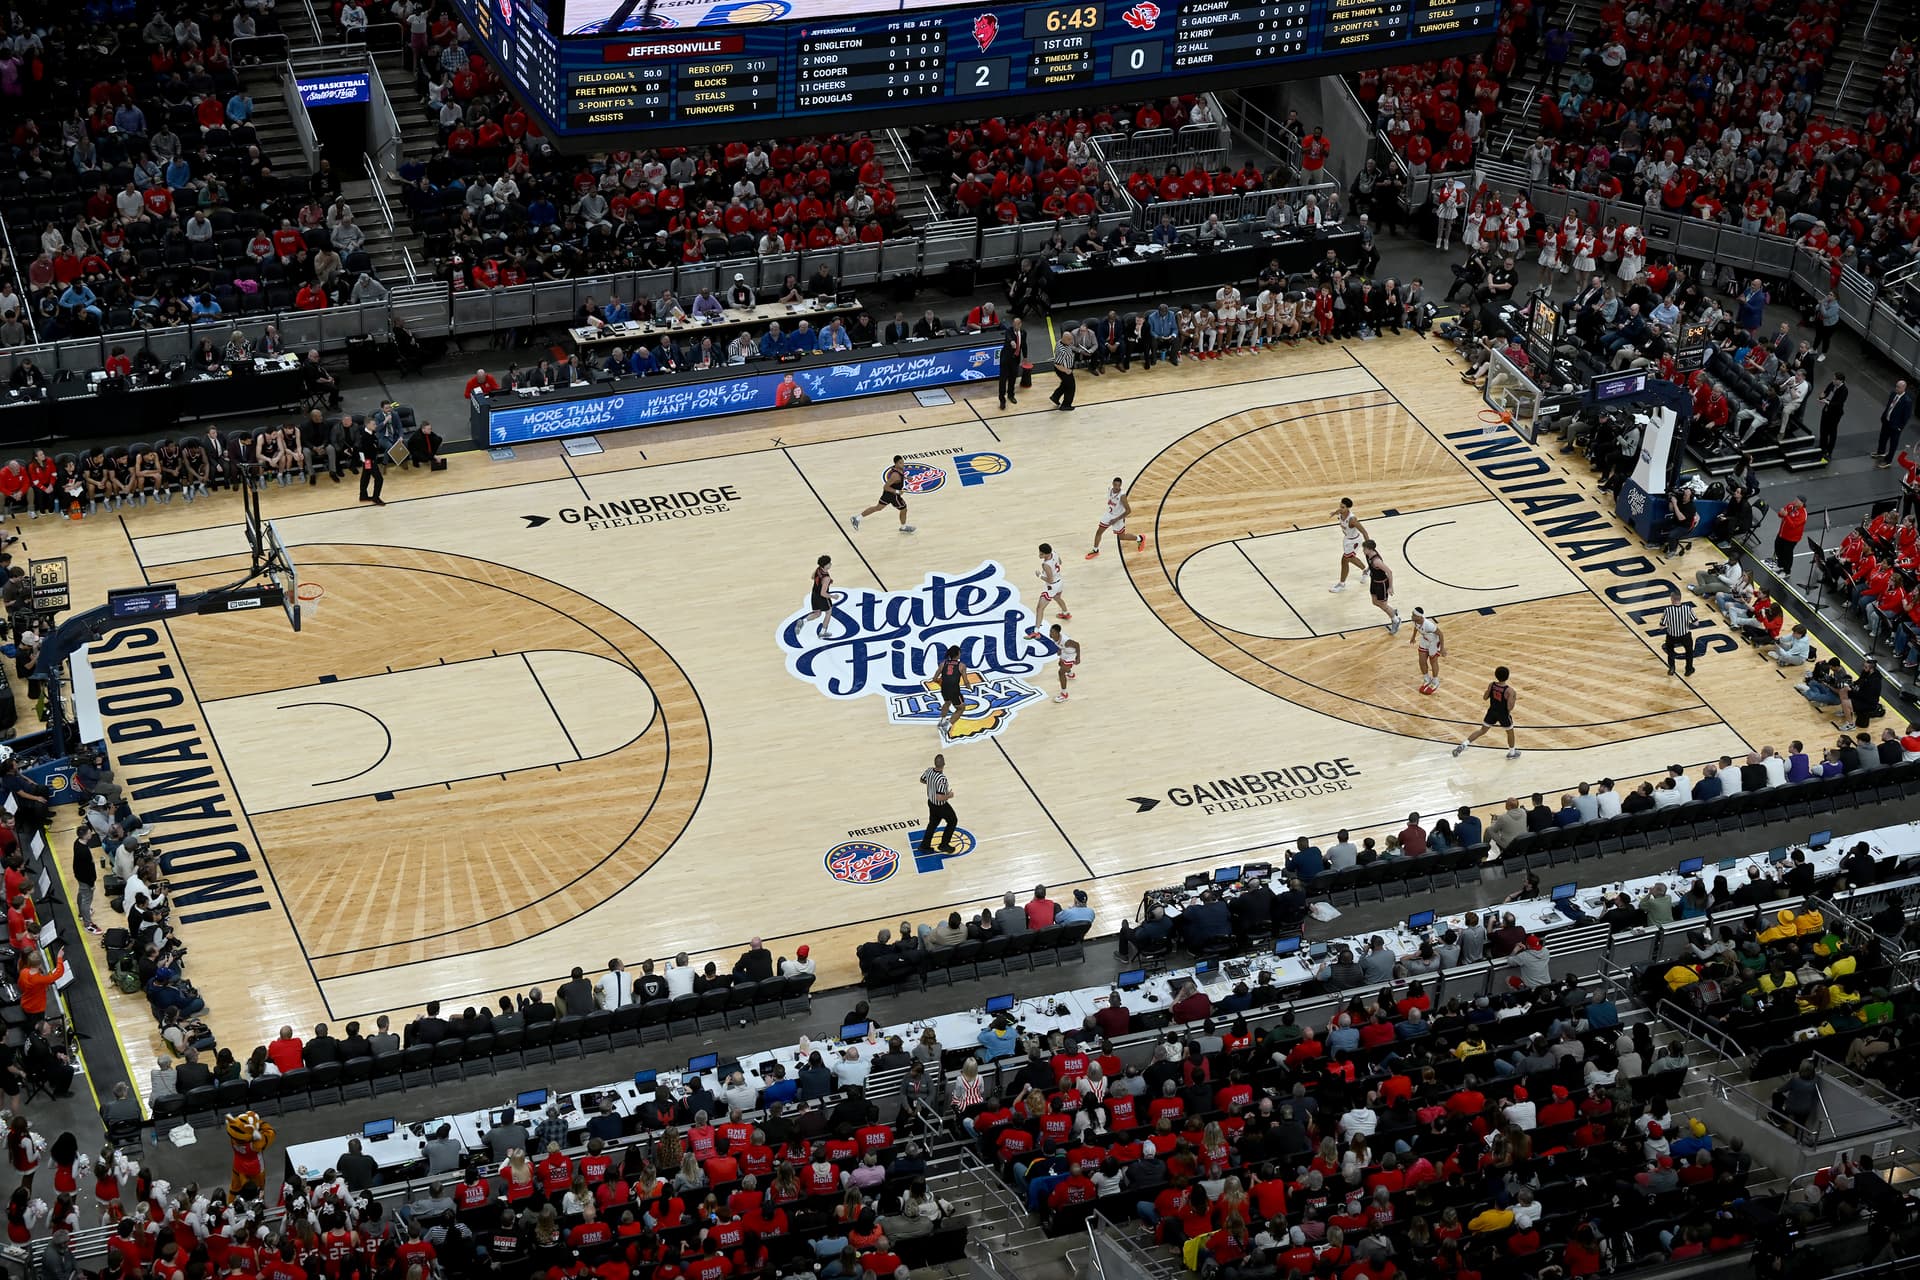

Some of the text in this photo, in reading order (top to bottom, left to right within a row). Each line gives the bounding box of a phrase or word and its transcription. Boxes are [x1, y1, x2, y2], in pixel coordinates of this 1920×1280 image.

[1192, 1, 1229, 12] ZACHARY
[1047, 7, 1097, 31] 6:43
[1191, 14, 1228, 25] GARDNER
[1229, 12, 1241, 21] JR.
[1332, 11, 1350, 20] FREE
[1351, 8, 1377, 17] THROW
[1428, 9, 1454, 19] STEALS
[811, 26, 856, 36] JEFFERSONVILLE
[1333, 22, 1362, 33] 3-POINT
[1420, 21, 1460, 33] TURNOVERS
[1179, 28, 1214, 40] 12 KIRBY
[1340, 34, 1370, 44] ASSISTS
[627, 41, 721, 57] JEFFERSONVILLE
[814, 39, 862, 51] SINGLETON
[1044, 37, 1082, 50] 1ST QTR
[1177, 42, 1209, 53] 22 HALL
[814, 55, 838, 64] NORD
[1045, 53, 1079, 63] TIMEOUTS
[1131, 49, 1144, 69] 0
[1188, 54, 1213, 64] BAKER
[688, 66, 710, 74] REBS
[711, 64, 733, 74] (OFF)
[754, 61, 765, 71] (1)
[813, 67, 848, 78] COOPER
[1050, 64, 1072, 72] FOULS
[578, 74, 602, 82] FIELD
[603, 72, 626, 81] GOAL
[644, 69, 662, 78] 50.0
[975, 66, 989, 86] 2
[1045, 74, 1075, 83] PENALTY
[319, 80, 366, 90] BASKETBALL
[694, 78, 727, 87] BLOCKS
[800, 84, 809, 92] 11
[813, 81, 846, 91] CHEEKS
[575, 88, 596, 96] FREE
[598, 85, 629, 95] THROW
[646, 83, 659, 91] 0.0
[695, 91, 726, 101] STEALS
[800, 97, 810, 105] 12
[812, 93, 852, 104] DOUGLAS
[578, 100, 612, 110] 3-POINT
[646, 97, 659, 105] 0.0
[685, 104, 734, 115] TURNOVERS
[589, 113, 623, 122] ASSISTS
[869, 356, 936, 377] APPLY NOW
[855, 380, 871, 392] AT
[648, 382, 748, 407] WHICH ONE IS
[640, 389, 759, 418] MEANT FOR YOU?
[523, 398, 624, 424] MORE THAN 70
[532, 414, 615, 434] PROGRAMS.
[902, 449, 952, 460] PRESENTED
[559, 485, 741, 524] GAINBRIDGE
[587, 503, 730, 531] FIELDHOUSE
[1444, 424, 1738, 659] INDIANAPOLIS
[783, 564, 1011, 648] State
[796, 610, 1061, 695] Finals
[88, 627, 271, 924] INDIANAPOLIS
[1167, 758, 1362, 807] GAINBRIDGE
[1201, 780, 1353, 815] FIELDHOUSE
[847, 819, 922, 838] PRESENTED BY
[832, 848, 897, 879] Fever
